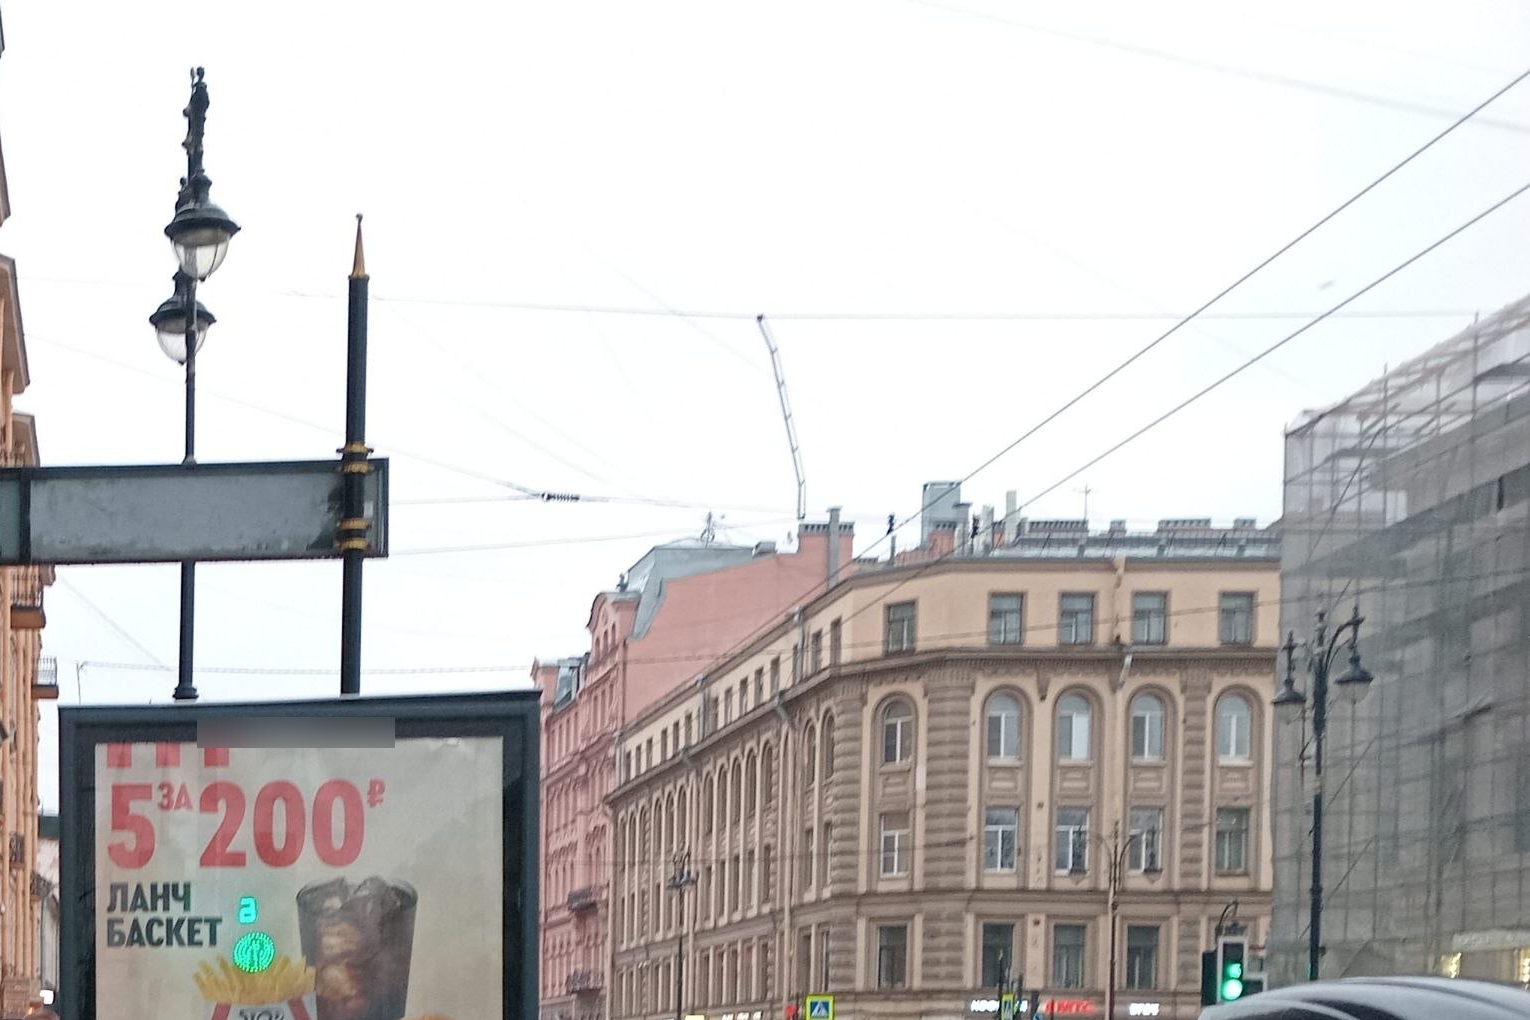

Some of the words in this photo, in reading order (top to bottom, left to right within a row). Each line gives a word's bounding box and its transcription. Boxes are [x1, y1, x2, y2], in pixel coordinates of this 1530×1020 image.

[107, 784, 155, 869] 5
[158, 783, 193, 811] ЗА
[107, 882, 191, 912] ЛАНЧ
[107, 917, 222, 947] БАСКЕТ
